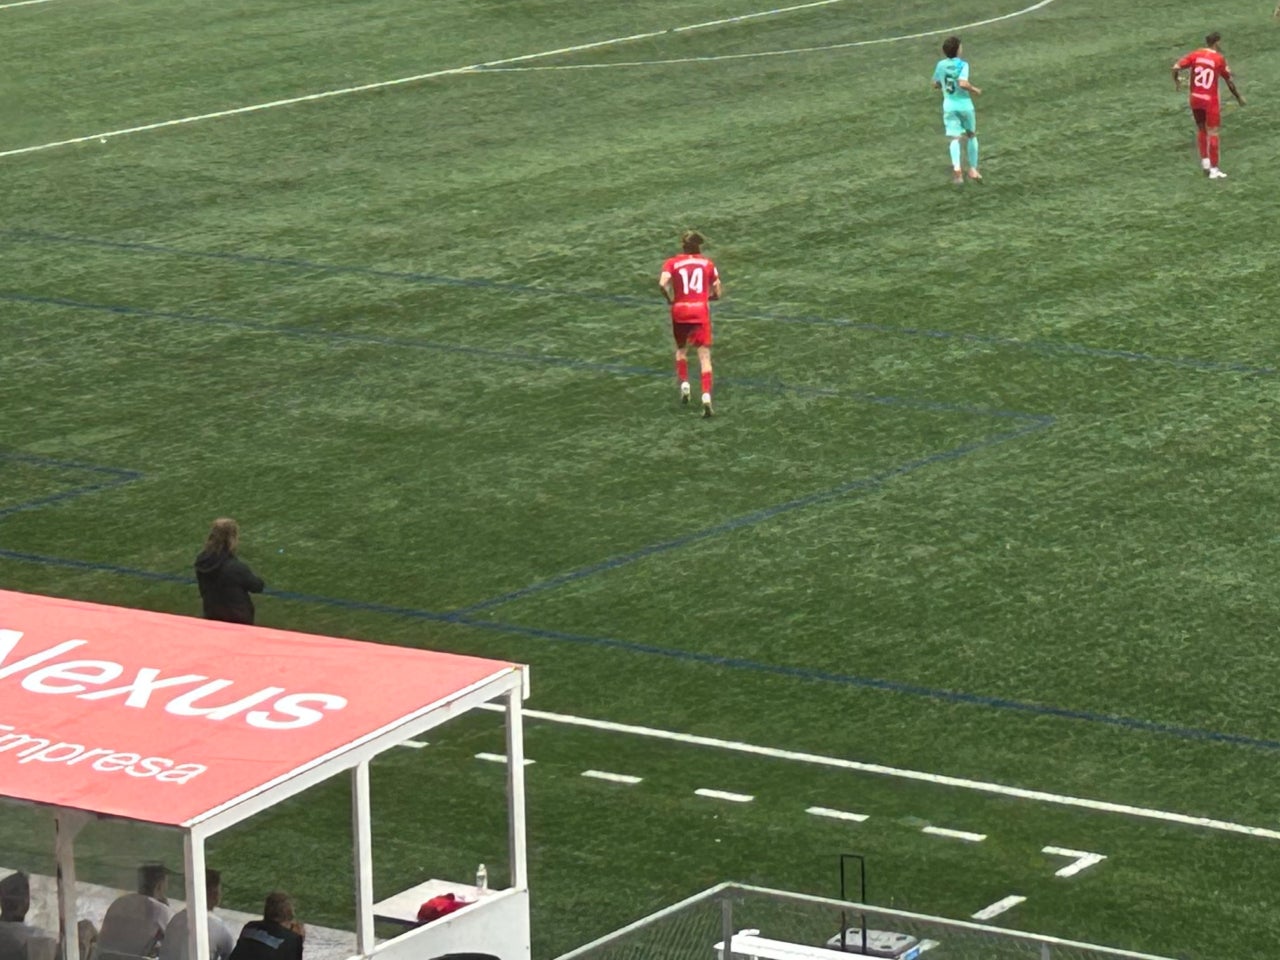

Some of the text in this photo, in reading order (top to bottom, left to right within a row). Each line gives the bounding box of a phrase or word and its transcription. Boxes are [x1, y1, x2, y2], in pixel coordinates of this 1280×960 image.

[1194, 66, 1215, 90] 20
[678, 266, 704, 296] 14
[0, 723, 208, 785] mpresa
